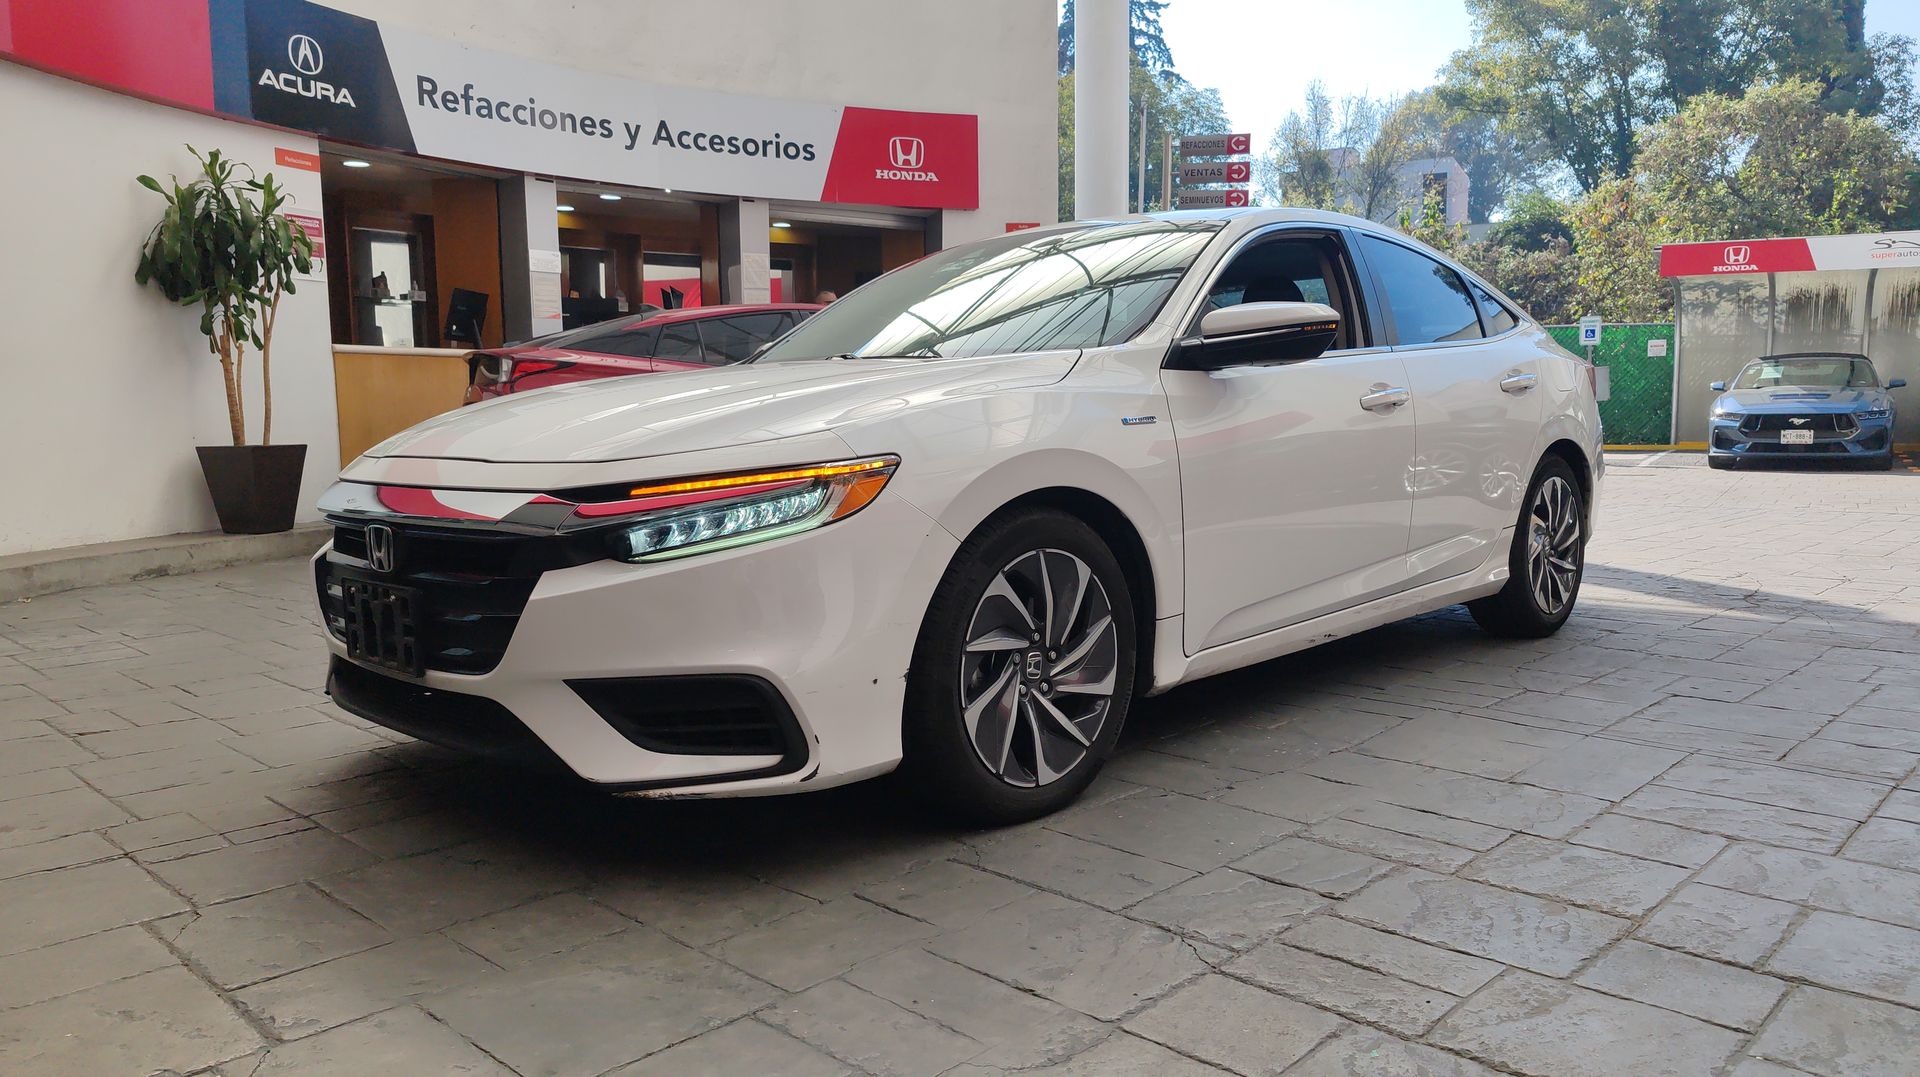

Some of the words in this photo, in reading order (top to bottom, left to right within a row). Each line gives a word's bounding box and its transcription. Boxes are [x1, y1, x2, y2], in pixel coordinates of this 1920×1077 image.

[258, 68, 357, 109] ACURA
[416, 74, 614, 139] Refacciones
[623, 122, 642, 151] y
[652, 119, 816, 162] Accesorios
[1181, 140, 1225, 150] REFACCIONES
[875, 169, 939, 182] HONDA
[1184, 168, 1223, 177] VENTAS
[1180, 195, 1224, 205] SEMINUEVOS
[1871, 250, 1920, 260] superauto
[1713, 264, 1759, 272] HONDA
